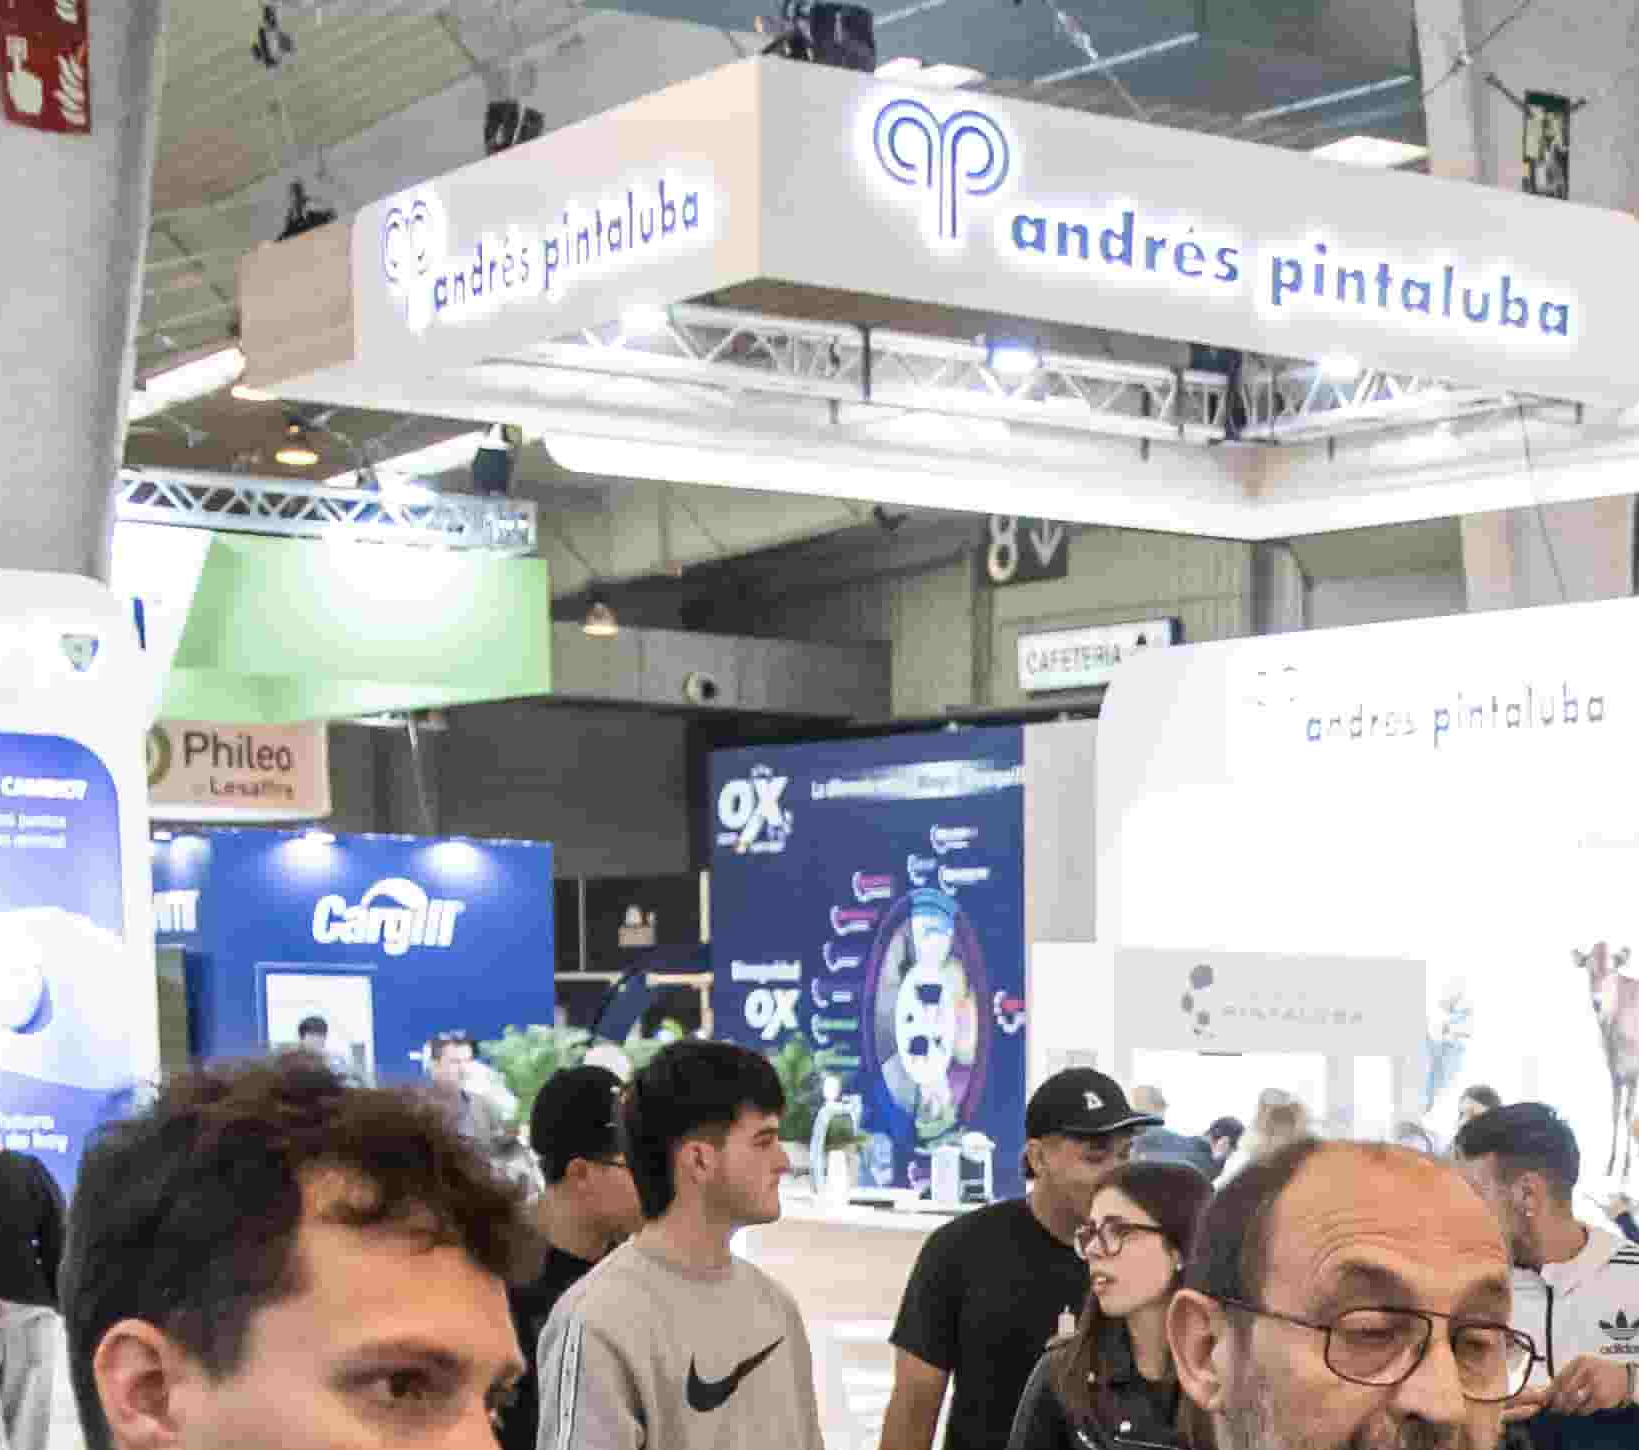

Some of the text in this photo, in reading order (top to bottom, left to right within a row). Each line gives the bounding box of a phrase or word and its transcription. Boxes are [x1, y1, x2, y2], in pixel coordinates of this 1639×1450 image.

[432, 179, 701, 315] andrés pintaluba
[1010, 208, 1570, 337] andrés pintaluba
[183, 730, 291, 771] Phileo
[312, 883, 467, 956] Cargill
